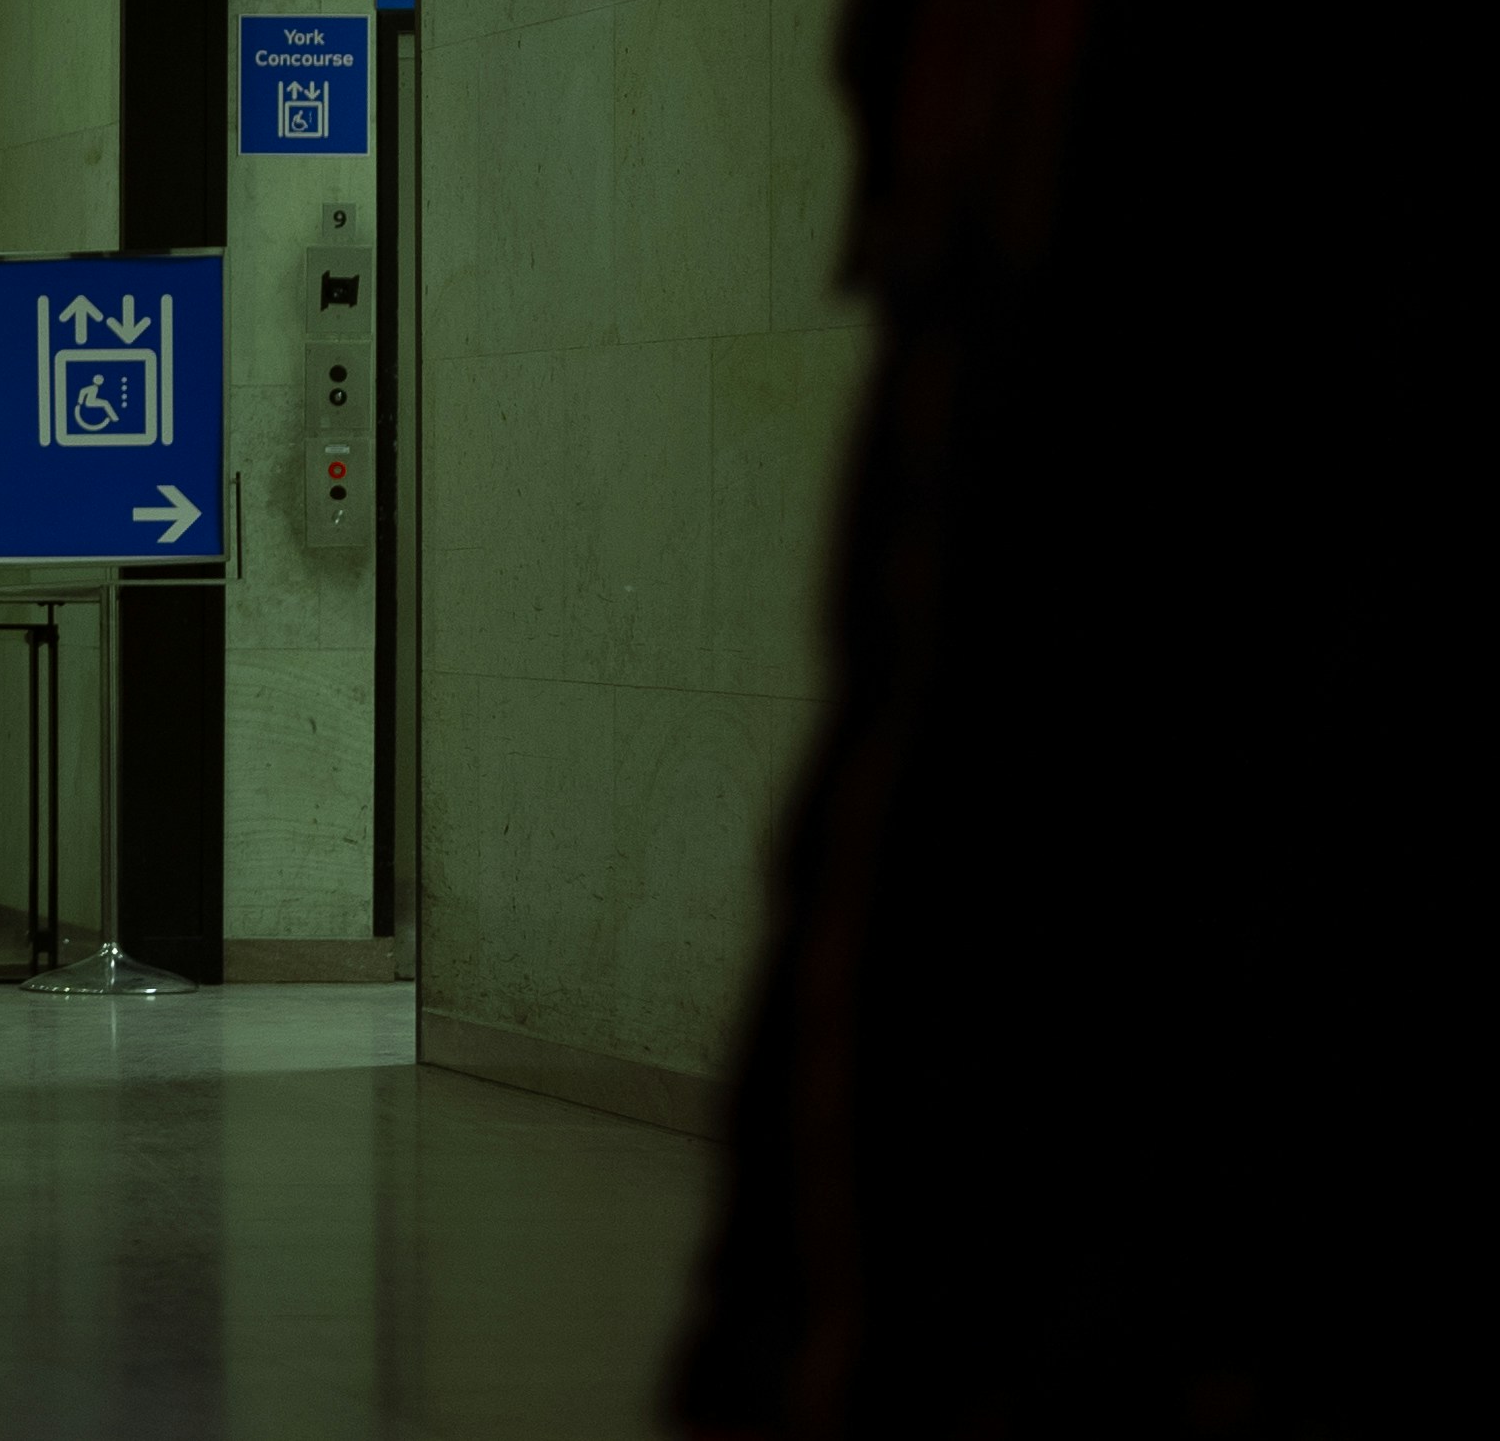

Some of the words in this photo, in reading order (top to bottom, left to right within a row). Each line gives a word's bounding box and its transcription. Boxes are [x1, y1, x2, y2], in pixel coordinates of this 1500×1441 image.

[283, 28, 326, 46] York
[255, 49, 355, 68] Concourse
[333, 210, 347, 229] 9
